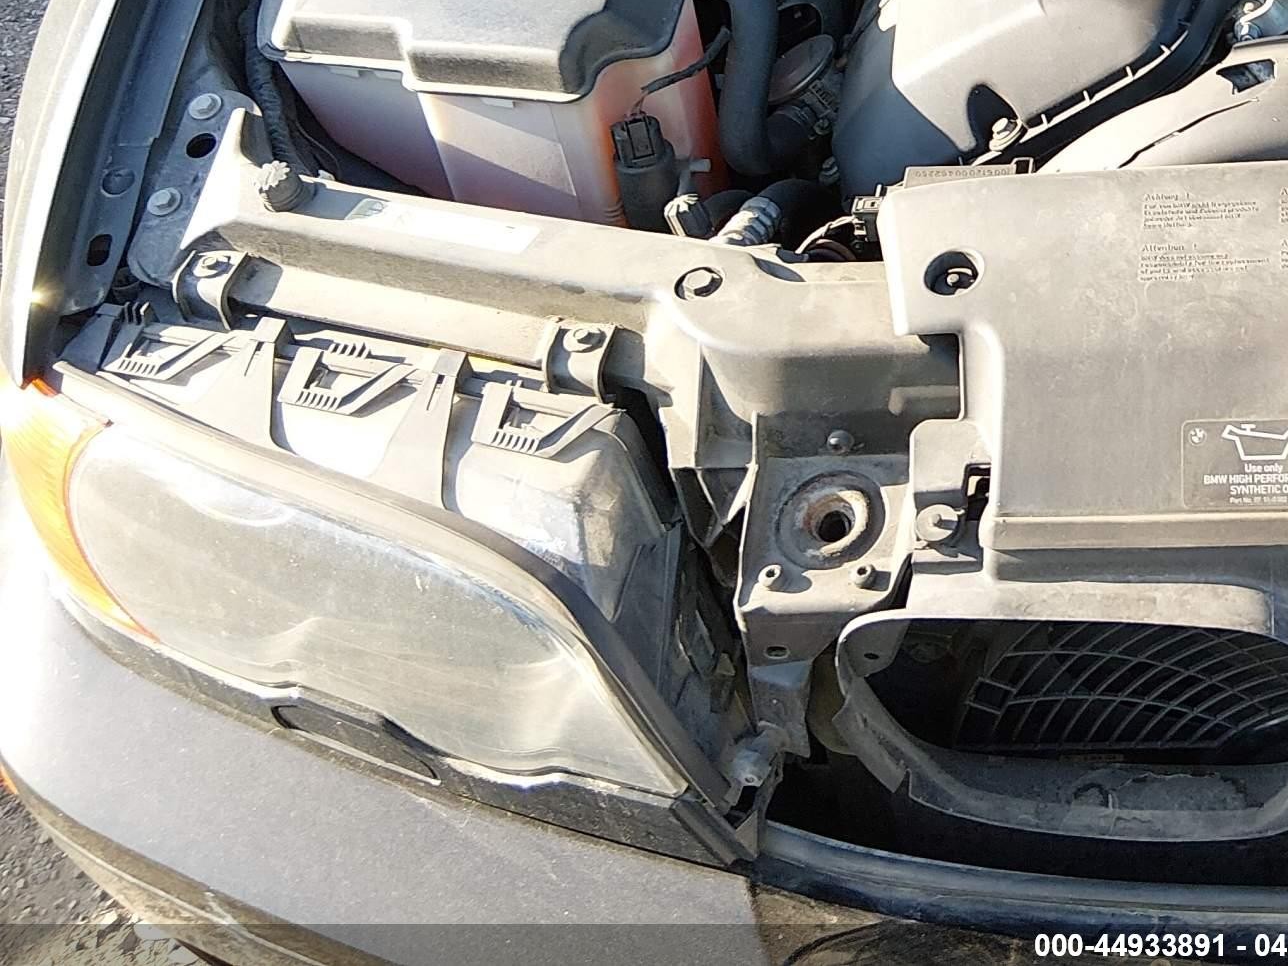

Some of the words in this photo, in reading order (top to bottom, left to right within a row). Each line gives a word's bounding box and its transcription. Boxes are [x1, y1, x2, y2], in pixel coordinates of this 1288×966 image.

[1244, 463, 1263, 473] Use
[1263, 463, 1283, 474] only
[1203, 474, 1228, 485] BMW
[1229, 474, 1253, 484] HIGH
[1230, 484, 1281, 495] SYNTHETIC
